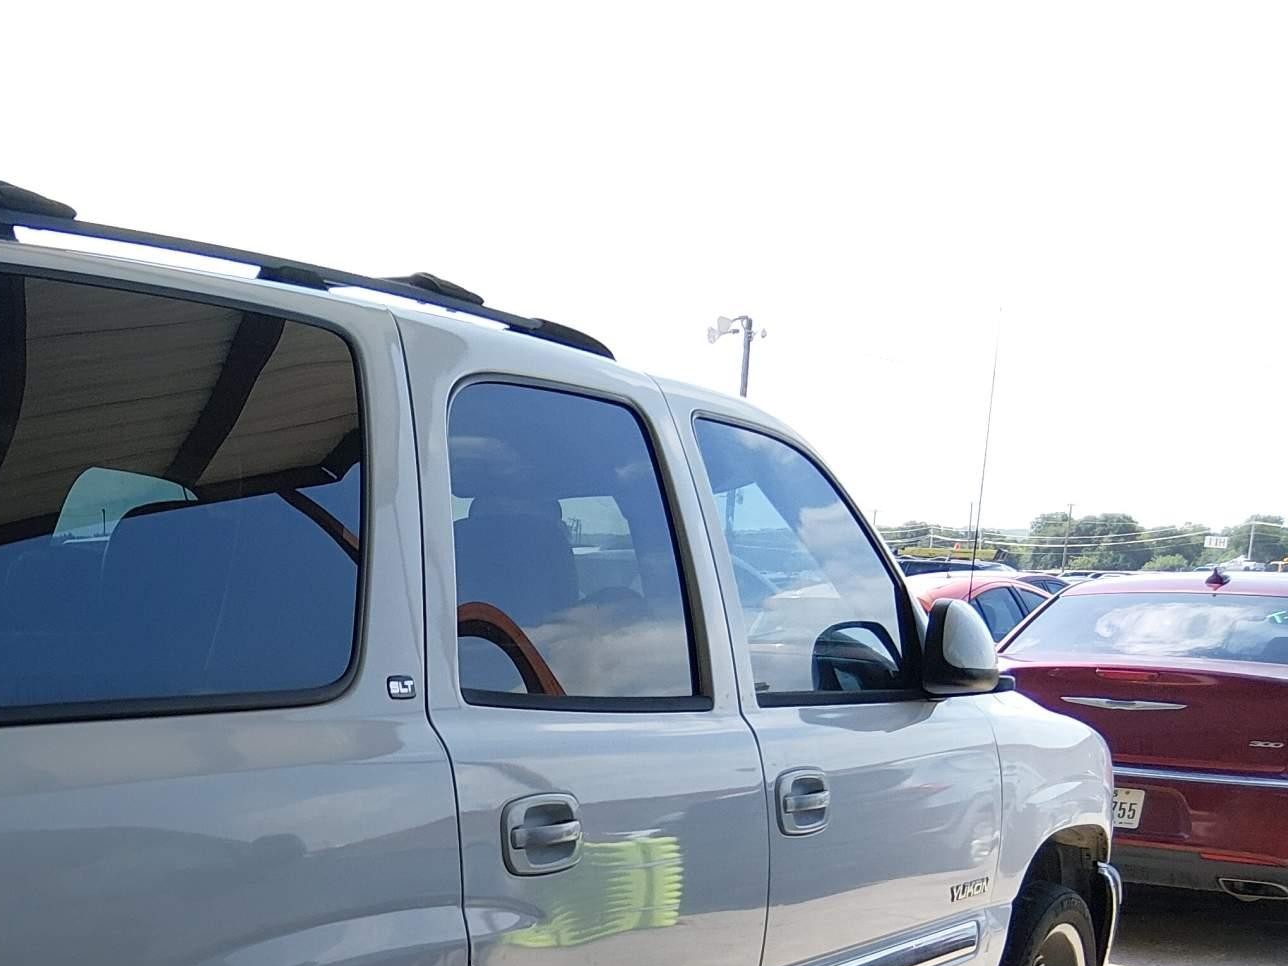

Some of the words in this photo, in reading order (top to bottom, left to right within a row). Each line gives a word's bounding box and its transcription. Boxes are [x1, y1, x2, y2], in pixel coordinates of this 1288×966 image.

[388, 680, 415, 694] SLT
[1248, 740, 1285, 748] 300
[950, 876, 990, 903] YUKON
